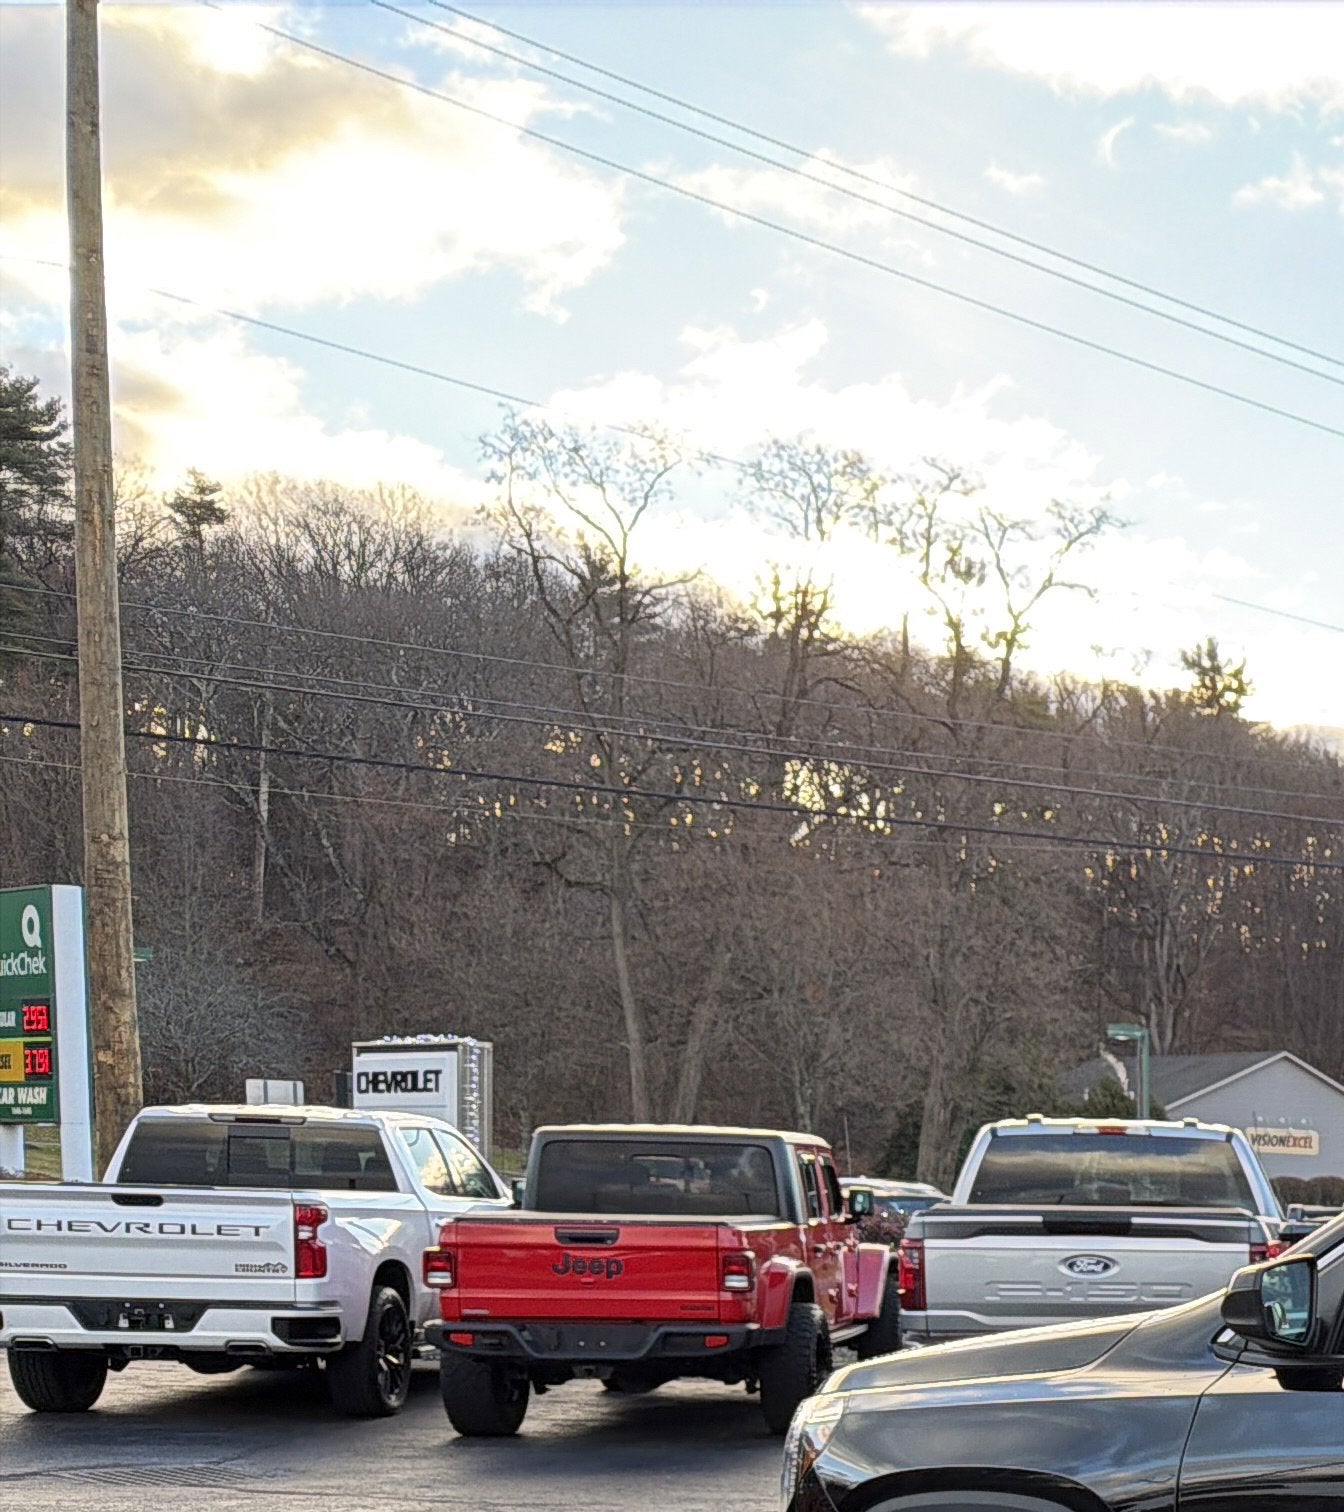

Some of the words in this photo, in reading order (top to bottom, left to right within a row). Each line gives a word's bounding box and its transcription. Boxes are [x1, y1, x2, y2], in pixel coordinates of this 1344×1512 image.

[356, 1069, 442, 1094] CHEVROLET
[16, 1086, 48, 1105] WASH
[7, 1219, 270, 1237] CHEVROLET
[552, 1252, 625, 1279] Jeep
[1073, 1258, 1106, 1273] Ford
